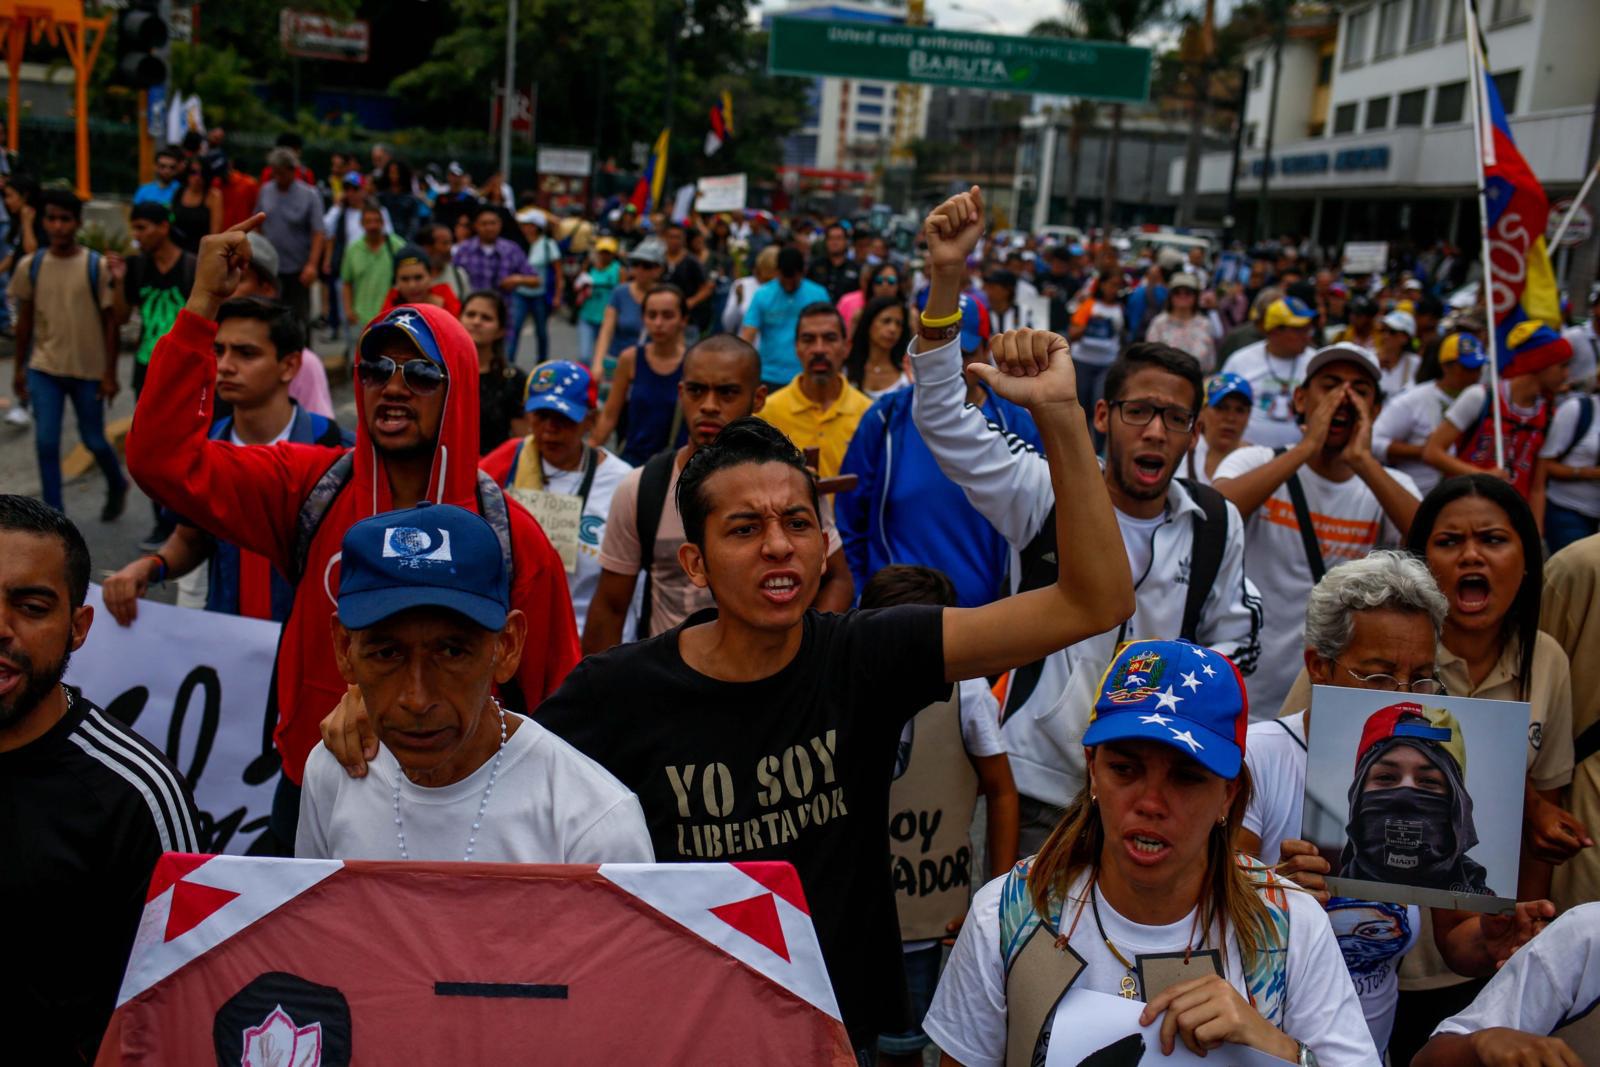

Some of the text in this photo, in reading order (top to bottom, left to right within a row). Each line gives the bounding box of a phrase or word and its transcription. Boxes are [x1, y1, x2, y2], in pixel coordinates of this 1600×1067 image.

[907, 50, 1009, 78] BARUTA
[665, 729, 837, 818] YO SOY
[677, 786, 849, 858] LIBERTADOR
